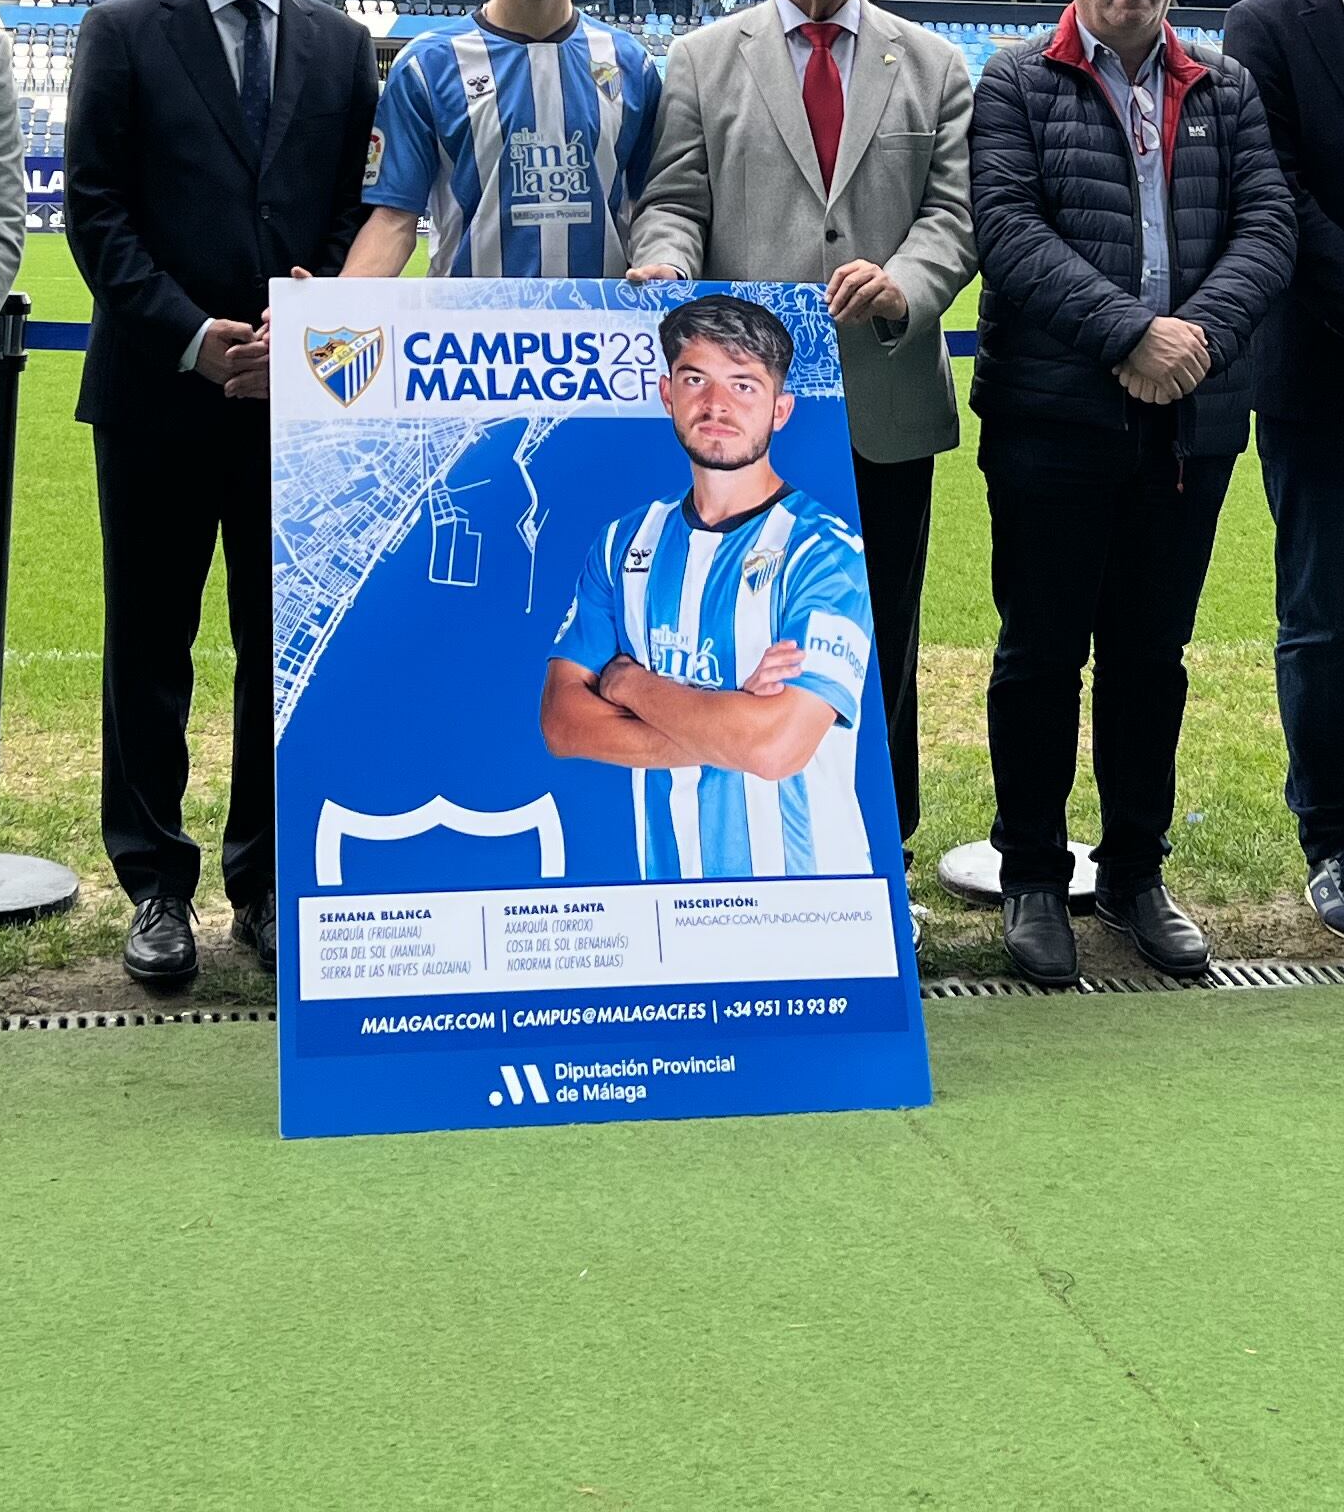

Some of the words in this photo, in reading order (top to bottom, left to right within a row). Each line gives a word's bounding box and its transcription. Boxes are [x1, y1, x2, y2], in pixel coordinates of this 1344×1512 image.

[504, 905, 558, 916] SEMANA
[564, 903, 605, 913] SANTA
[674, 895, 758, 909] INSCRIPCIÓN:
[319, 911, 375, 922] SEMANA
[381, 909, 432, 920] BLANCA
[320, 925, 364, 941] AXARQUÍA
[368, 925, 422, 940] (FRIGILIANA)
[505, 918, 548, 934] AXARQUÍA
[552, 919, 593, 933] (TORROX)
[506, 939, 533, 953] COSTA
[536, 938, 550, 951] DEL
[555, 937, 570, 951] SOL
[574, 933, 628, 951] (BENAHAVÍS)
[321, 947, 348, 960] COSTA
[351, 946, 366, 959] DEL
[370, 945, 386, 958] SOL
[390, 944, 435, 958] (MANILVA)
[321, 965, 351, 979] SIERRA
[354, 965, 365, 978] DE
[369, 964, 384, 977] LAS
[388, 963, 418, 976] NIEVES
[422, 961, 471, 976] (ALOZAINA)
[507, 957, 551, 971] NORORMA
[555, 956, 591, 970] (CUEVAS
[594, 954, 624, 968] BAJAS)
[361, 1012, 495, 1034] MALAGACF.COM
[513, 1003, 706, 1027] CAMPUS@MALAGACF.ES
[723, 1000, 752, 1018] +34
[754, 999, 781, 1017] 951
[787, 999, 804, 1016] 13
[807, 998, 825, 1014] 93
[828, 997, 848, 1014] 89
[555, 1059, 648, 1083] Diputación
[652, 1055, 736, 1075] Provincial
[556, 1085, 579, 1102] de
[583, 1082, 647, 1104] Málaga
